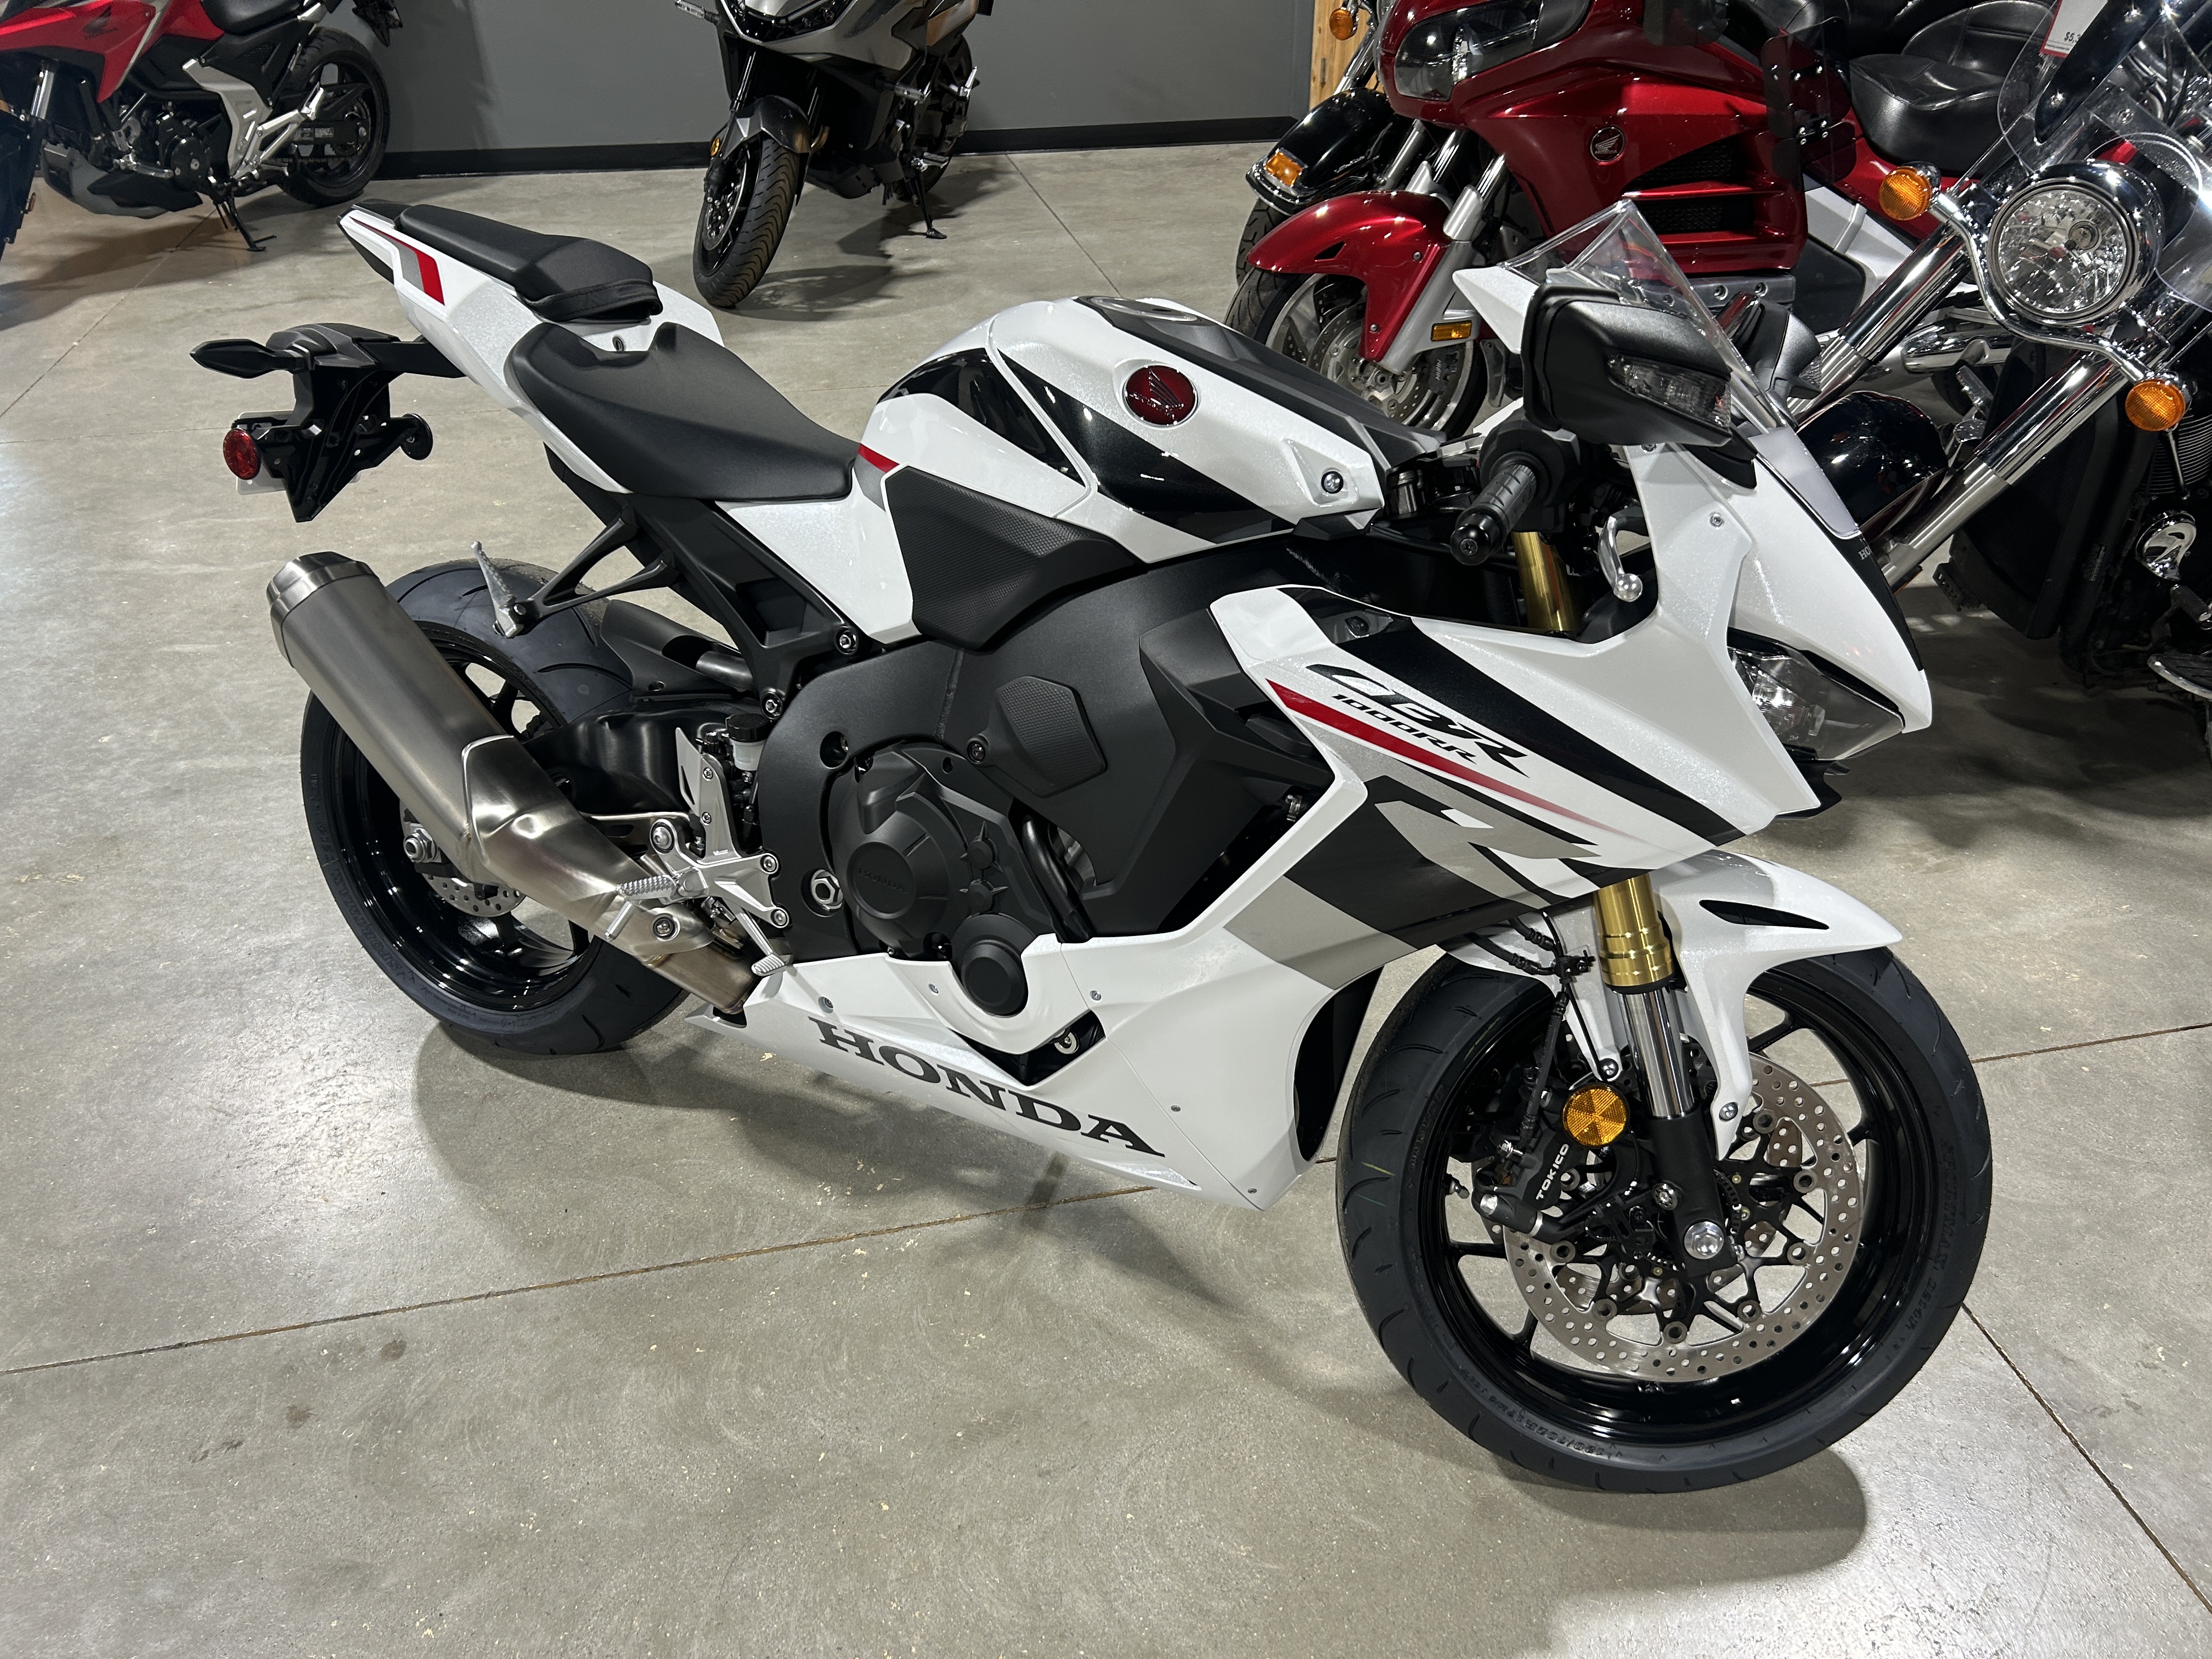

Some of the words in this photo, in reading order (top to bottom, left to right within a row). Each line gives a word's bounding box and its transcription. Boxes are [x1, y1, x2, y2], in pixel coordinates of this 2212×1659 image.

[1858, 546, 1871, 560] HO
[1306, 664, 1530, 778] CBR
[1331, 693, 1477, 764] 1000RR
[858, 867, 909, 895] HONDA
[808, 1015, 1165, 1158] HONDA
[1536, 1143, 1570, 1200] TOKICO
